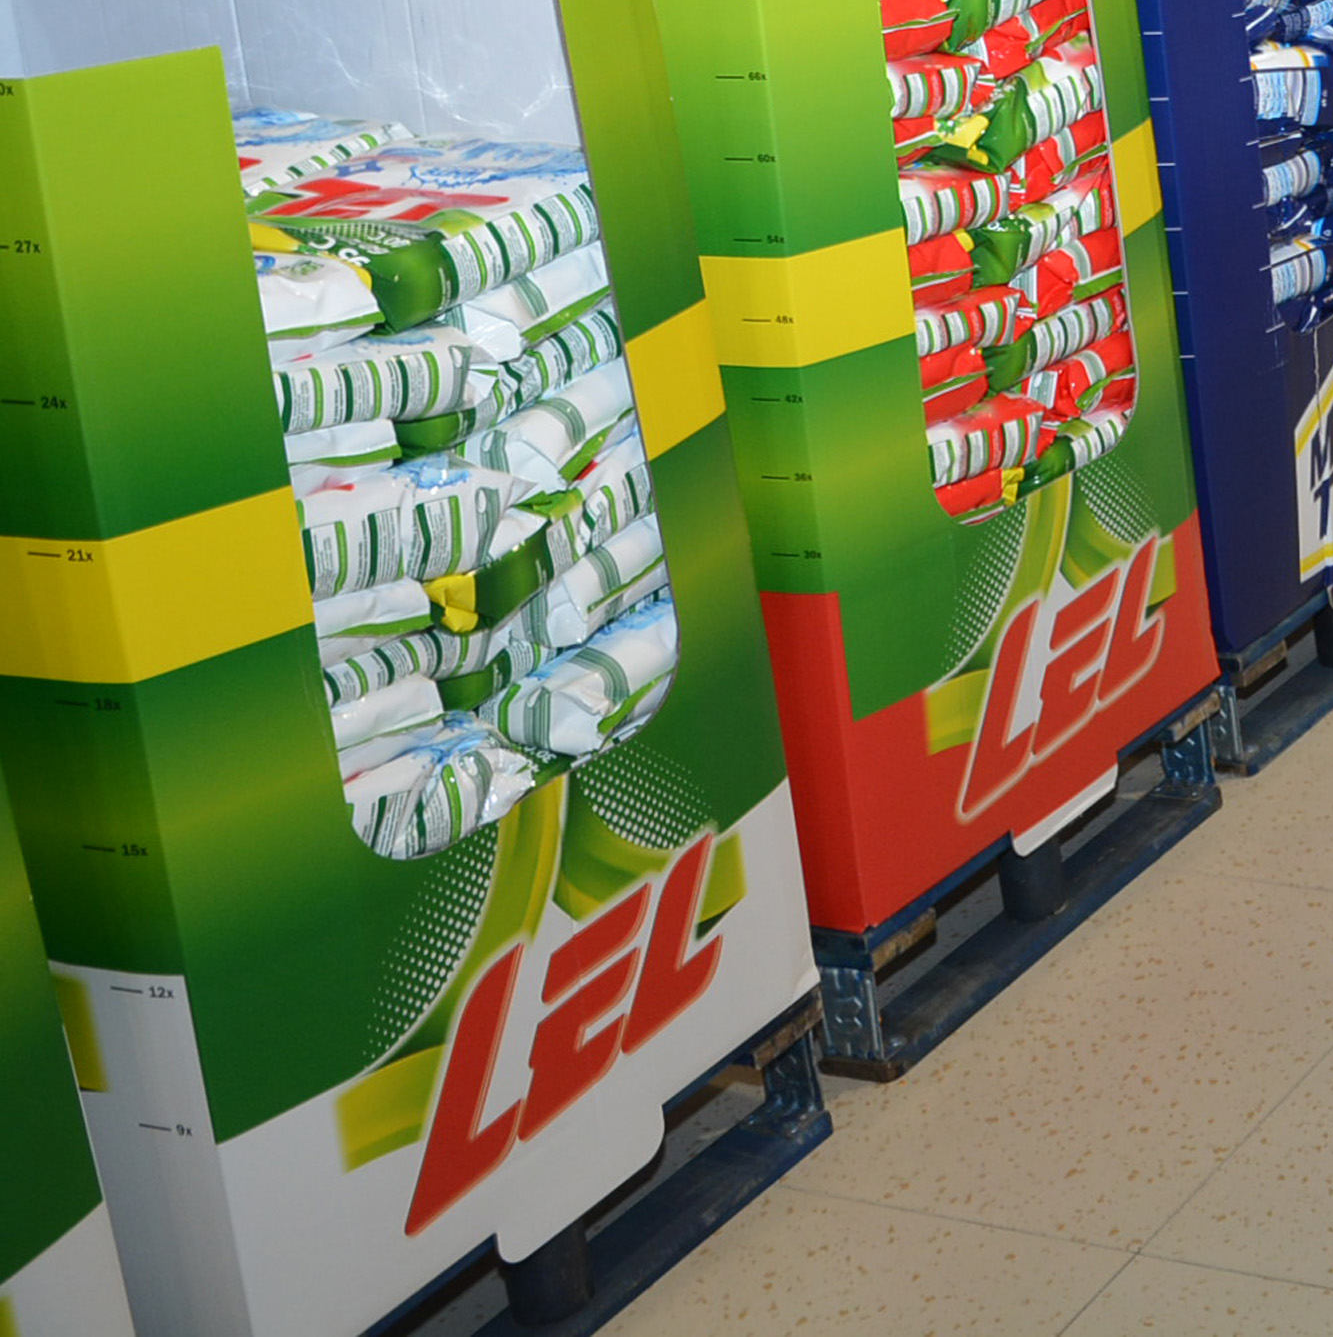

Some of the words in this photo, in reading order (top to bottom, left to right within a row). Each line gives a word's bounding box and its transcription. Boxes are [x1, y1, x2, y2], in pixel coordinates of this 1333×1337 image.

[748, 71, 767, 81] 66x
[757, 154, 776, 163] 60x
[14, 240, 41, 254] 27x
[775, 315, 794, 325] 48x
[40, 396, 68, 411] 24x
[66, 548, 94, 564] 21x
[960, 535, 1163, 821] LEL
[95, 698, 121, 711] 18x
[122, 844, 148, 857] 15x
[149, 986, 174, 1000] 12x
[405, 833, 723, 1237] LEL
[176, 1125, 193, 1138] 9x
